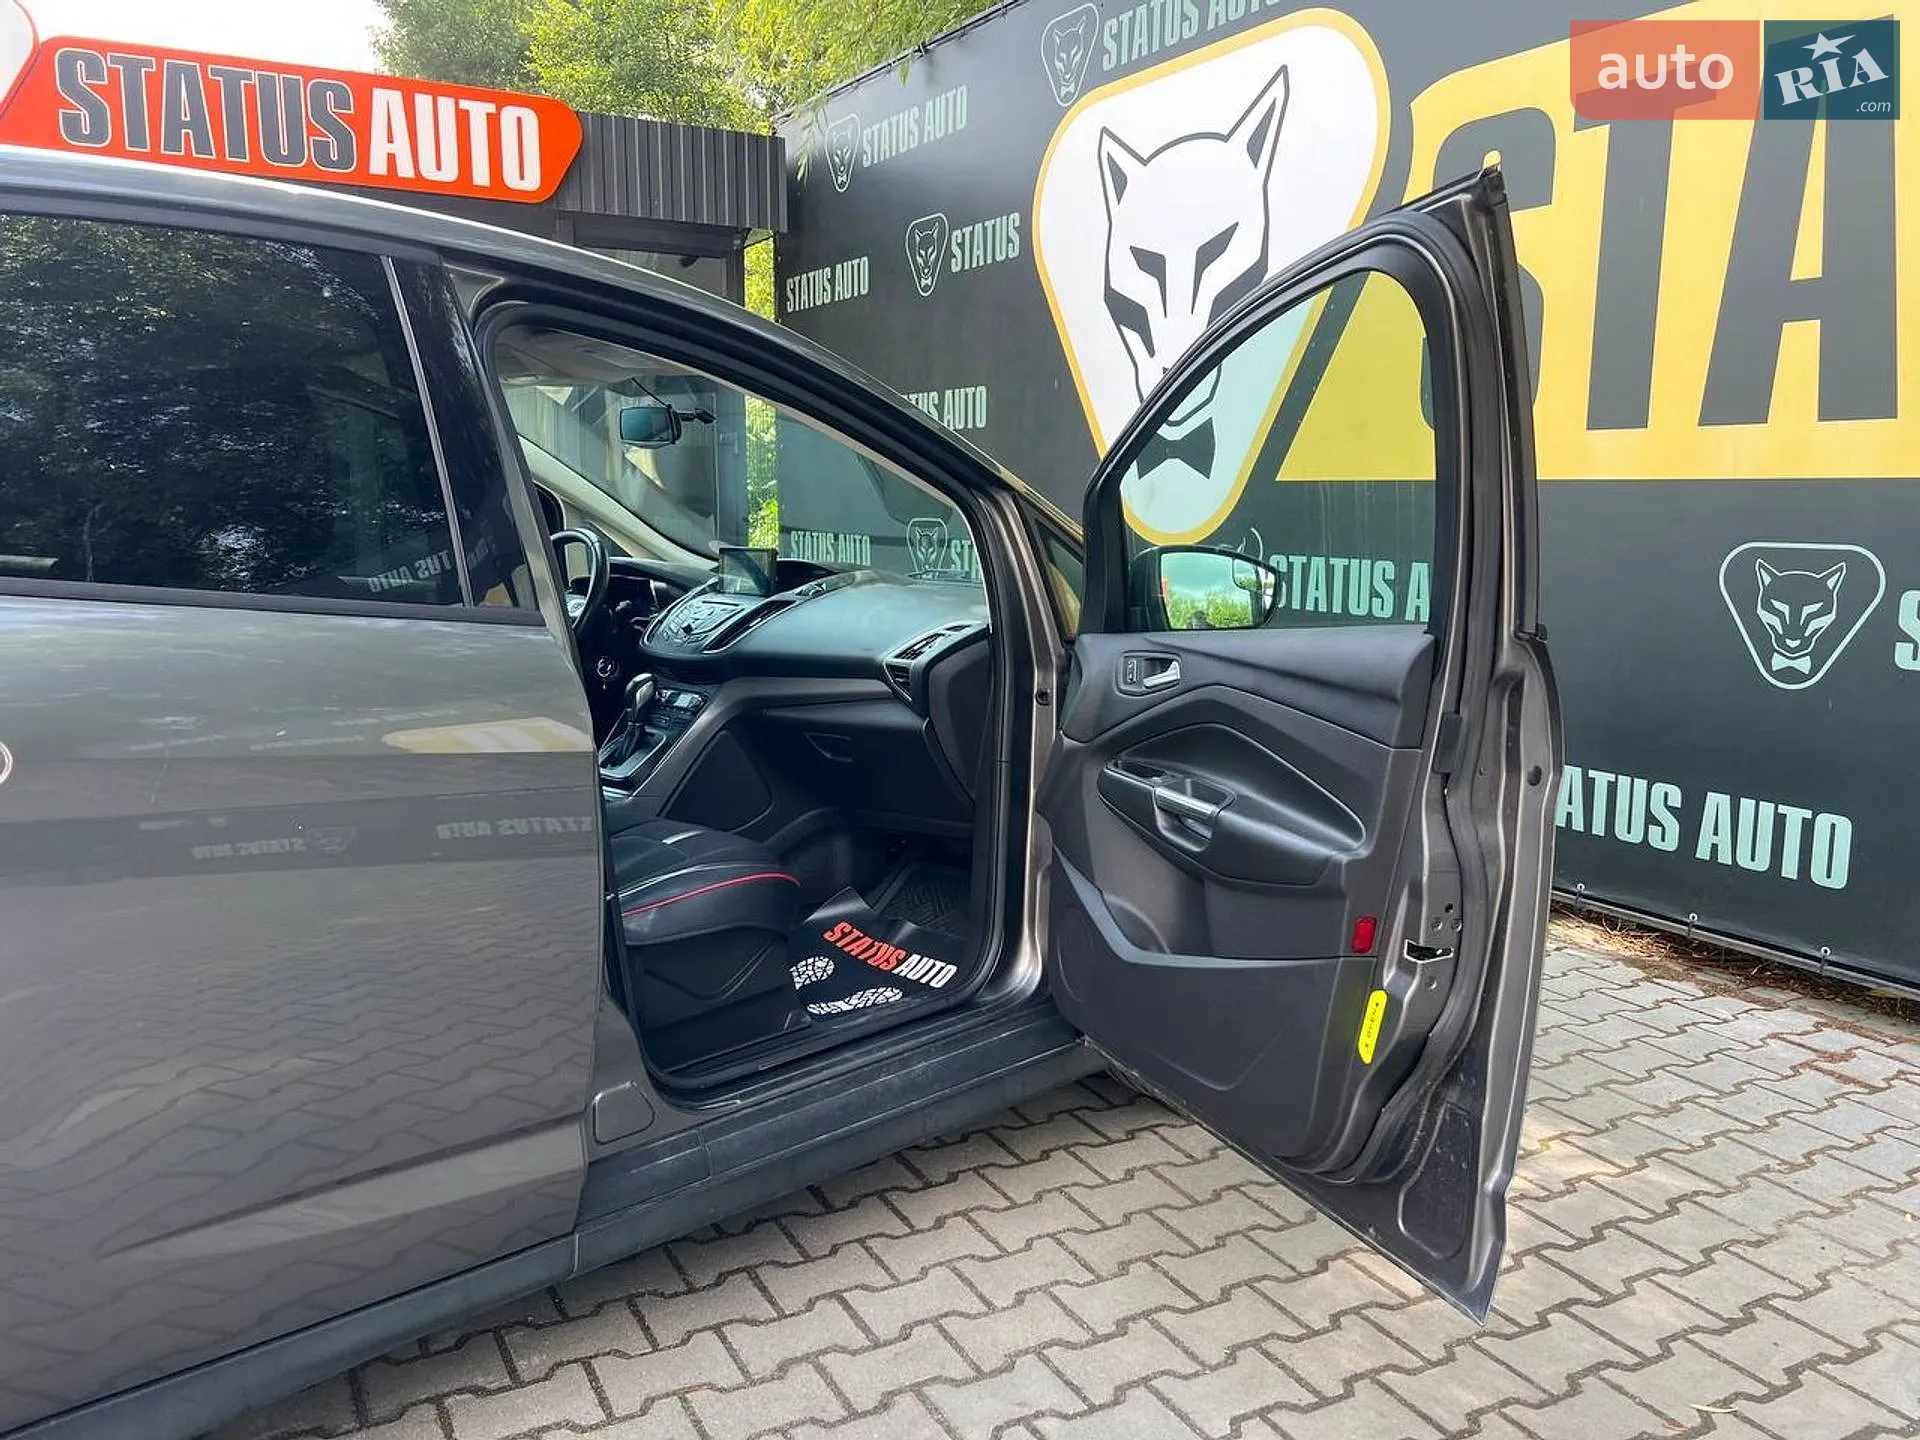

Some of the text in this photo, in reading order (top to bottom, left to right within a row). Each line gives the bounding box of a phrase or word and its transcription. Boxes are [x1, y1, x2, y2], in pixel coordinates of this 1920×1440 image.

[1102, 0, 1199, 72] STATUS
[54, 46, 542, 193] STATUS AUTO
[862, 85, 968, 168] STATUS AUTO
[950, 212, 1021, 273] STATUS
[786, 256, 870, 313] STATUS AUTO
[943, 385, 987, 431] AUTO
[790, 530, 872, 567] STATUS AUTO
[1695, 791, 1853, 890] AUTO
[823, 921, 958, 989] STATUS AUTO
